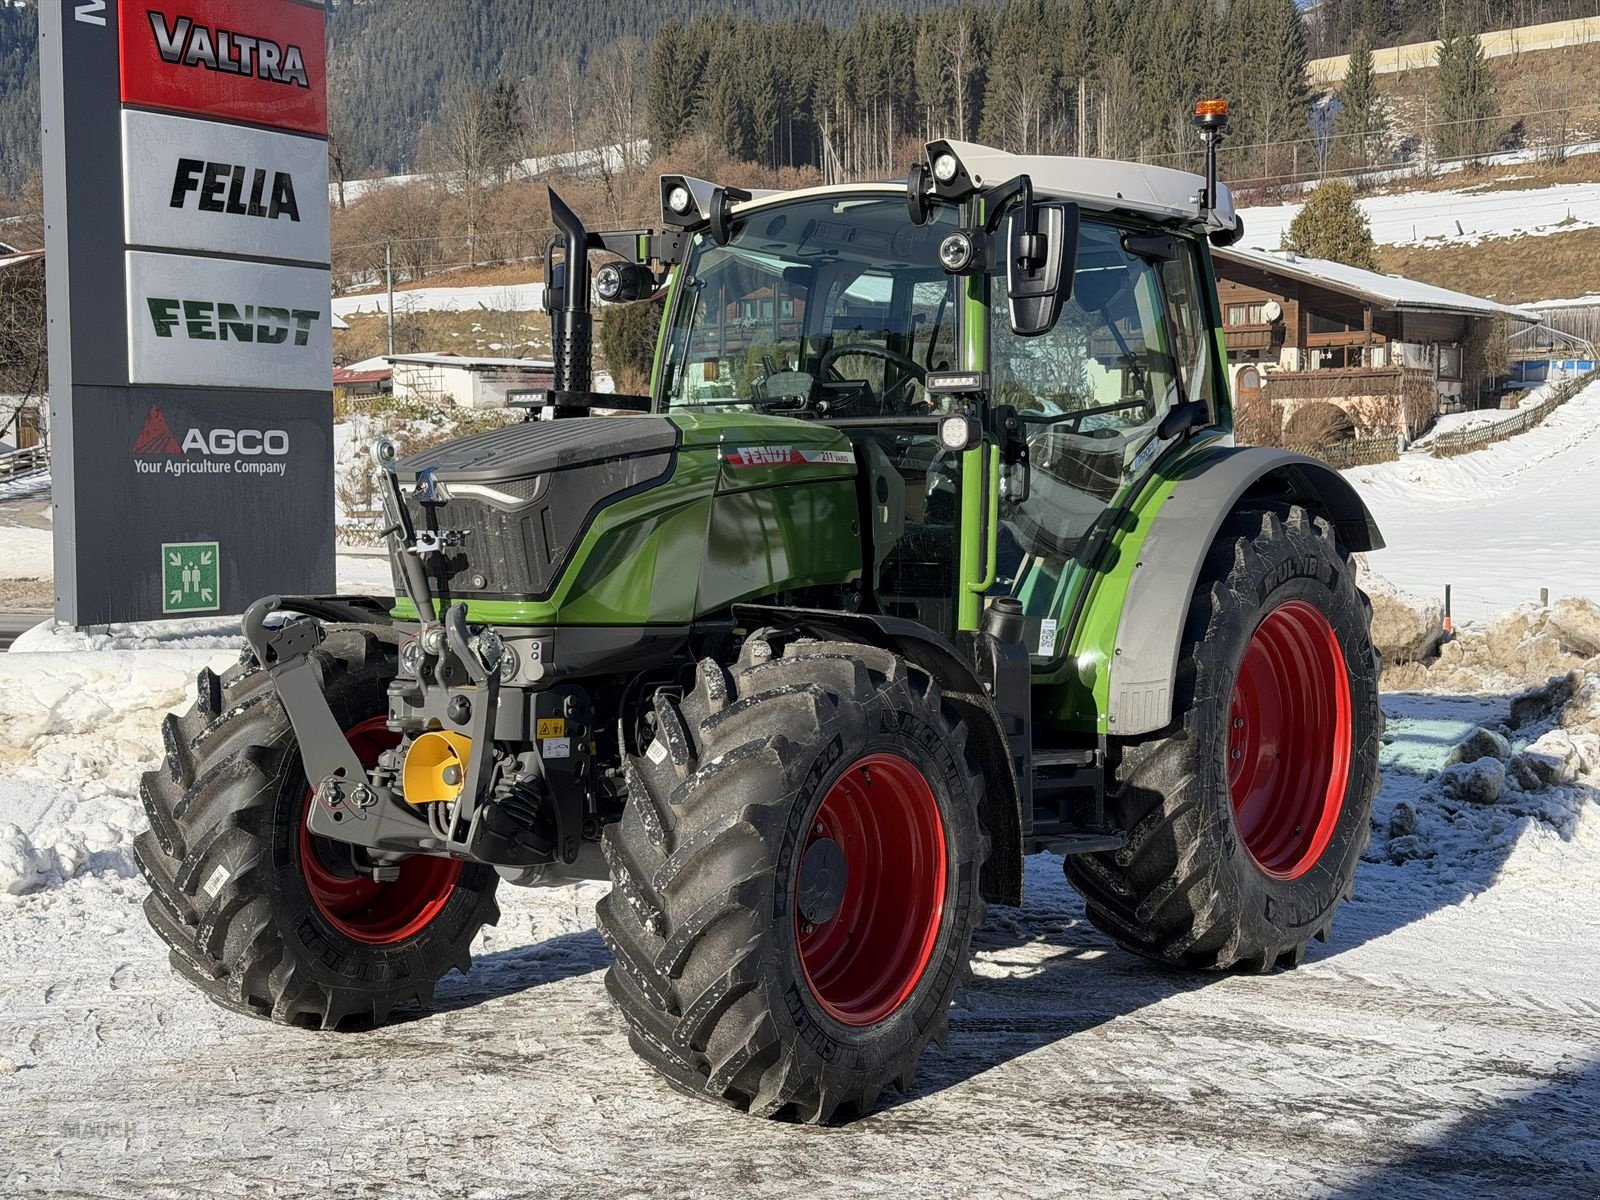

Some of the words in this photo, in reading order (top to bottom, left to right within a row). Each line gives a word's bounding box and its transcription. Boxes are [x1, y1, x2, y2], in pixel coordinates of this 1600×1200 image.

[147, 10, 310, 88] VALTRA
[170, 158, 300, 222] FELLA
[147, 297, 320, 346] FENDT
[182, 428, 289, 455] AGCO
[737, 446, 792, 464] FENDT
[134, 459, 162, 473] Your
[165, 459, 231, 477] Agriculture
[234, 460, 286, 476] Company
[821, 451, 833, 462] 211
[835, 455, 849, 463] VARIO
